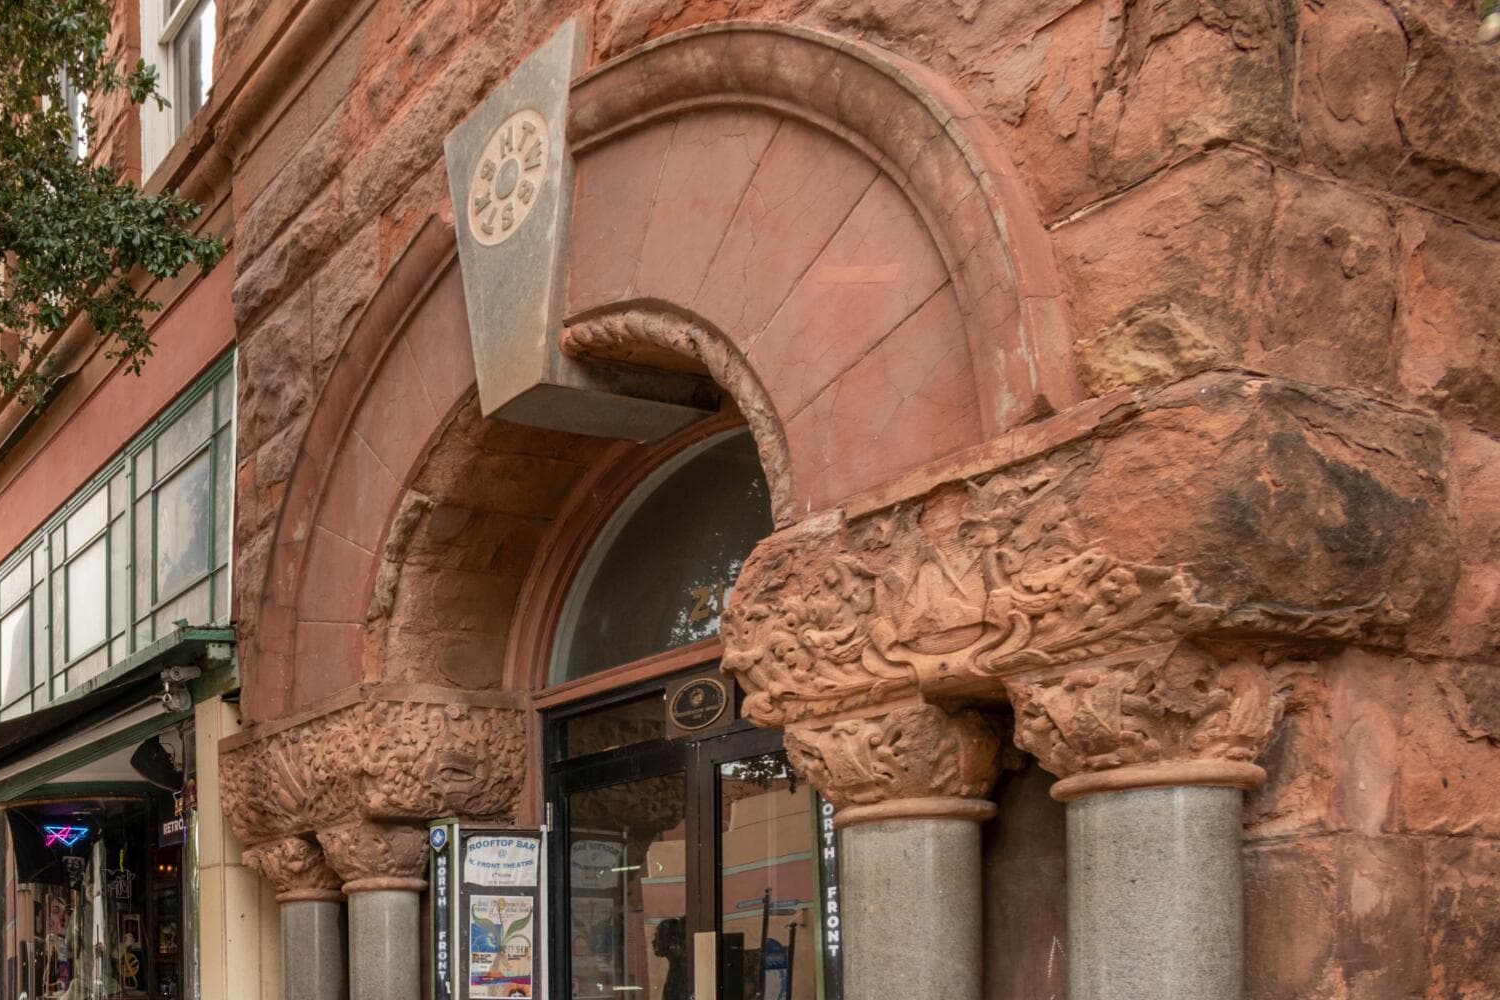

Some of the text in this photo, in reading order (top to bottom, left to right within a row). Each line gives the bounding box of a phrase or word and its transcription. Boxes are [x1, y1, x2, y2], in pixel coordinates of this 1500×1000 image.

[163, 819, 184, 835] RETRO
[469, 839, 536, 852] ROOFTOP BAR
[822, 798, 835, 860] ORTH
[437, 857, 447, 907] NORTH
[477, 861, 501, 869] FRONT
[503, 859, 534, 869] THEATRE
[827, 886, 839, 957] FRONT
[438, 932, 447, 980] FRONT
